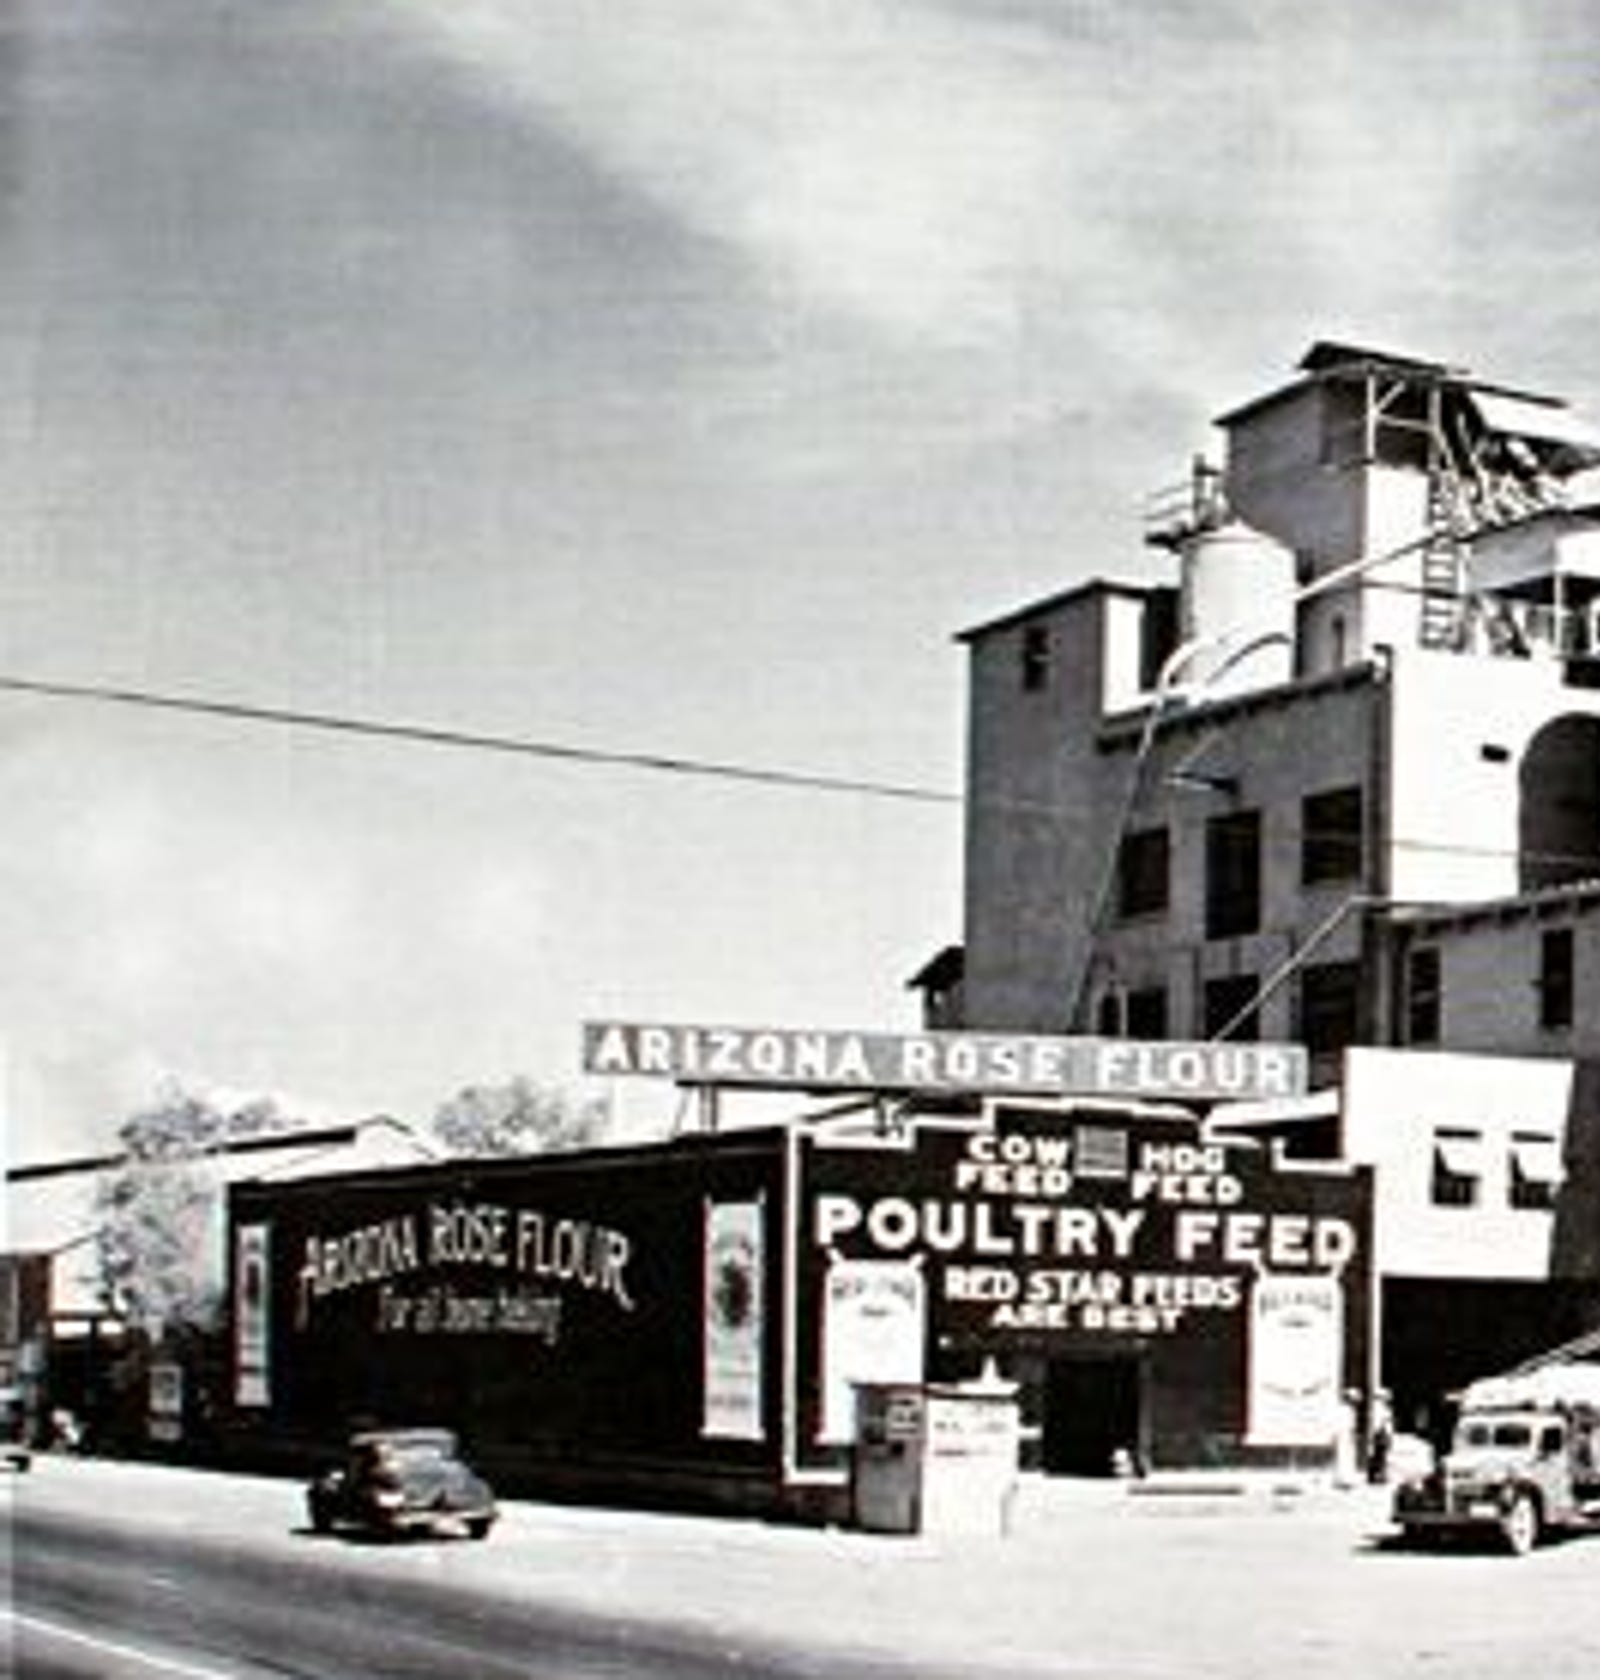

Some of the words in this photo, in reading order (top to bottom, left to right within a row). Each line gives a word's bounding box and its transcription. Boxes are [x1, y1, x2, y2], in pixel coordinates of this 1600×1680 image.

[598, 1026, 872, 1082] ARIZONA
[902, 1038, 1066, 1086] ROSE
[1097, 1044, 1294, 1093] FLOUR
[968, 1135, 1070, 1164] COW
[1140, 1144, 1226, 1172] HOG
[956, 1165, 1072, 1195] FEED
[1131, 1175, 1242, 1204] FEED
[817, 1195, 1145, 1257] POULTRY
[1175, 1212, 1356, 1264] FEED
[295, 1213, 419, 1333] ARIZONA
[428, 1203, 508, 1265] ROSE
[516, 1207, 636, 1311] FLOUR
[944, 1266, 1020, 1301] RED
[1026, 1270, 1122, 1304] STAR
[1131, 1274, 1242, 1308] FEEDS
[990, 1302, 1069, 1329] ARE
[1081, 1305, 1184, 1332] BEST
